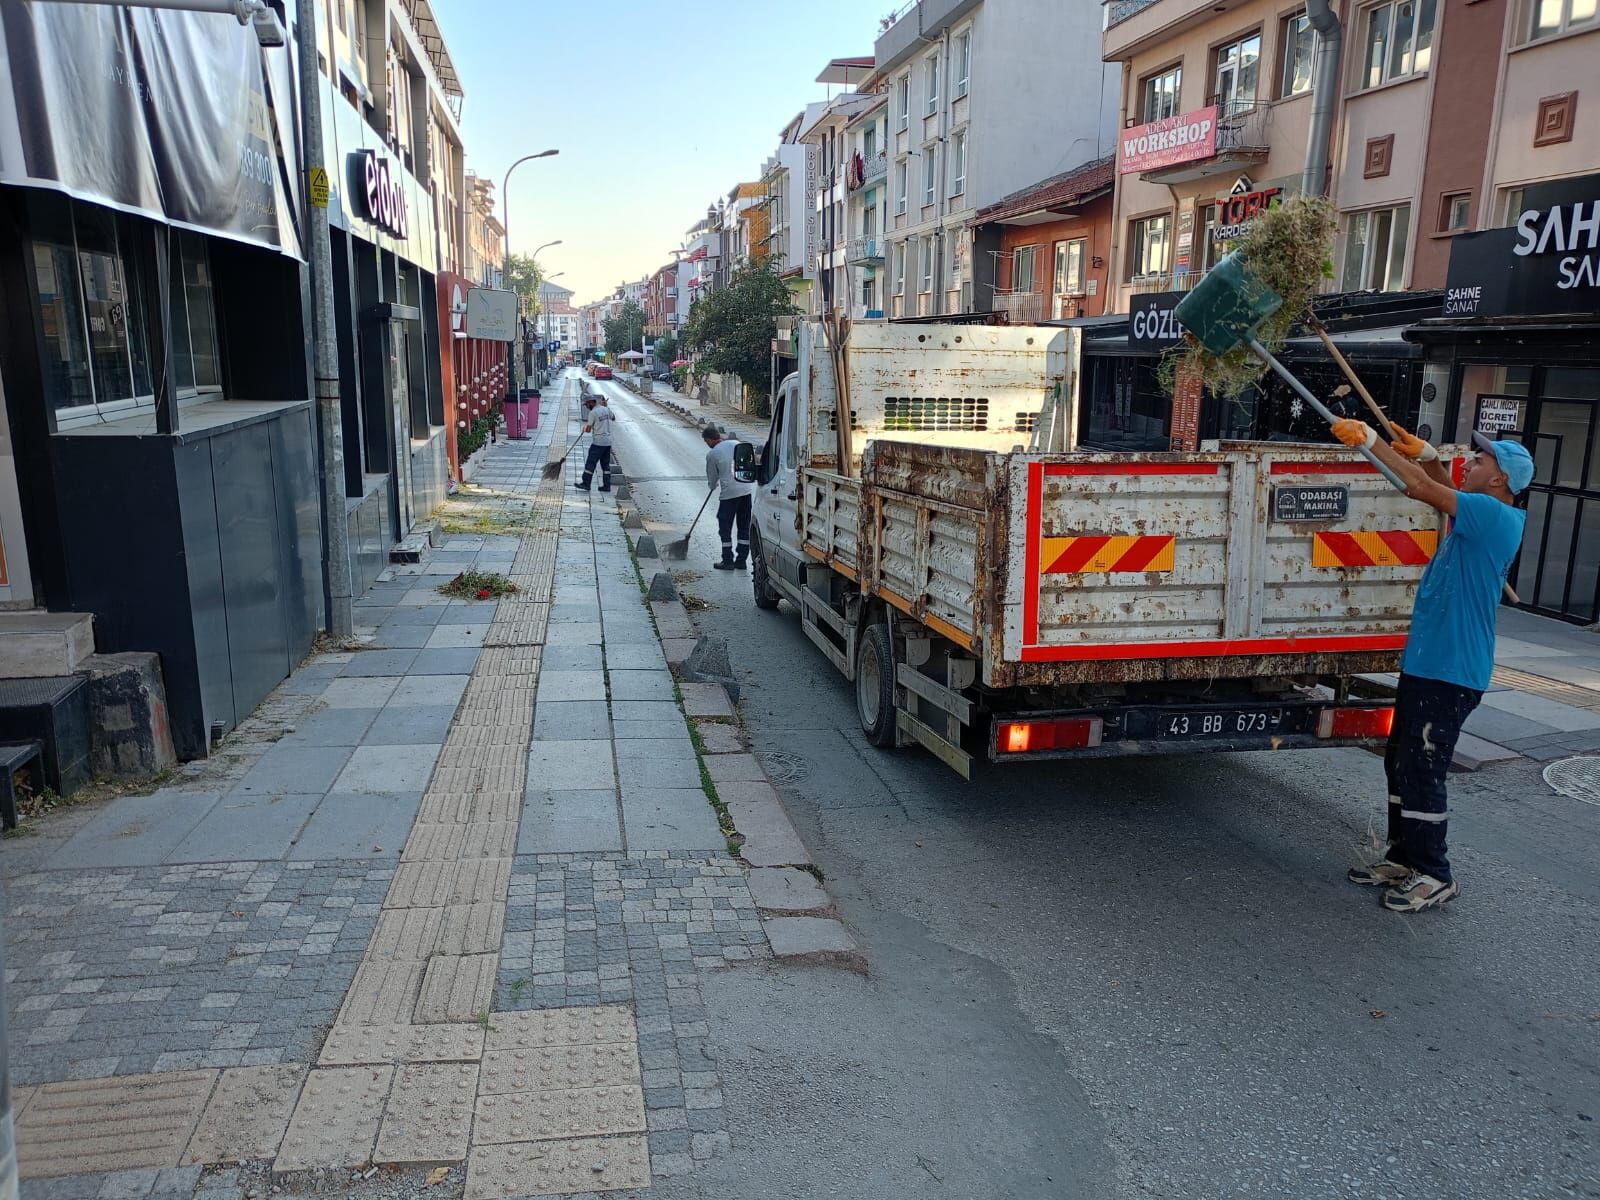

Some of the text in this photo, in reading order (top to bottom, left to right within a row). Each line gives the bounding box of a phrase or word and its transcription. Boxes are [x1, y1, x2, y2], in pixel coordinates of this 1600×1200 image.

[1171, 114, 1189, 128] ART
[1123, 119, 1211, 158] WORKSHOP
[807, 151, 816, 273] BOHEME SUITES
[1512, 200, 1600, 256] SAH
[1556, 254, 1600, 290] SA
[1447, 286, 1482, 301] SAHNE
[1445, 299, 1480, 314] SANAT
[1300, 491, 1342, 501] ODABAŞI
[1170, 713, 1267, 734] 43 BB 673
